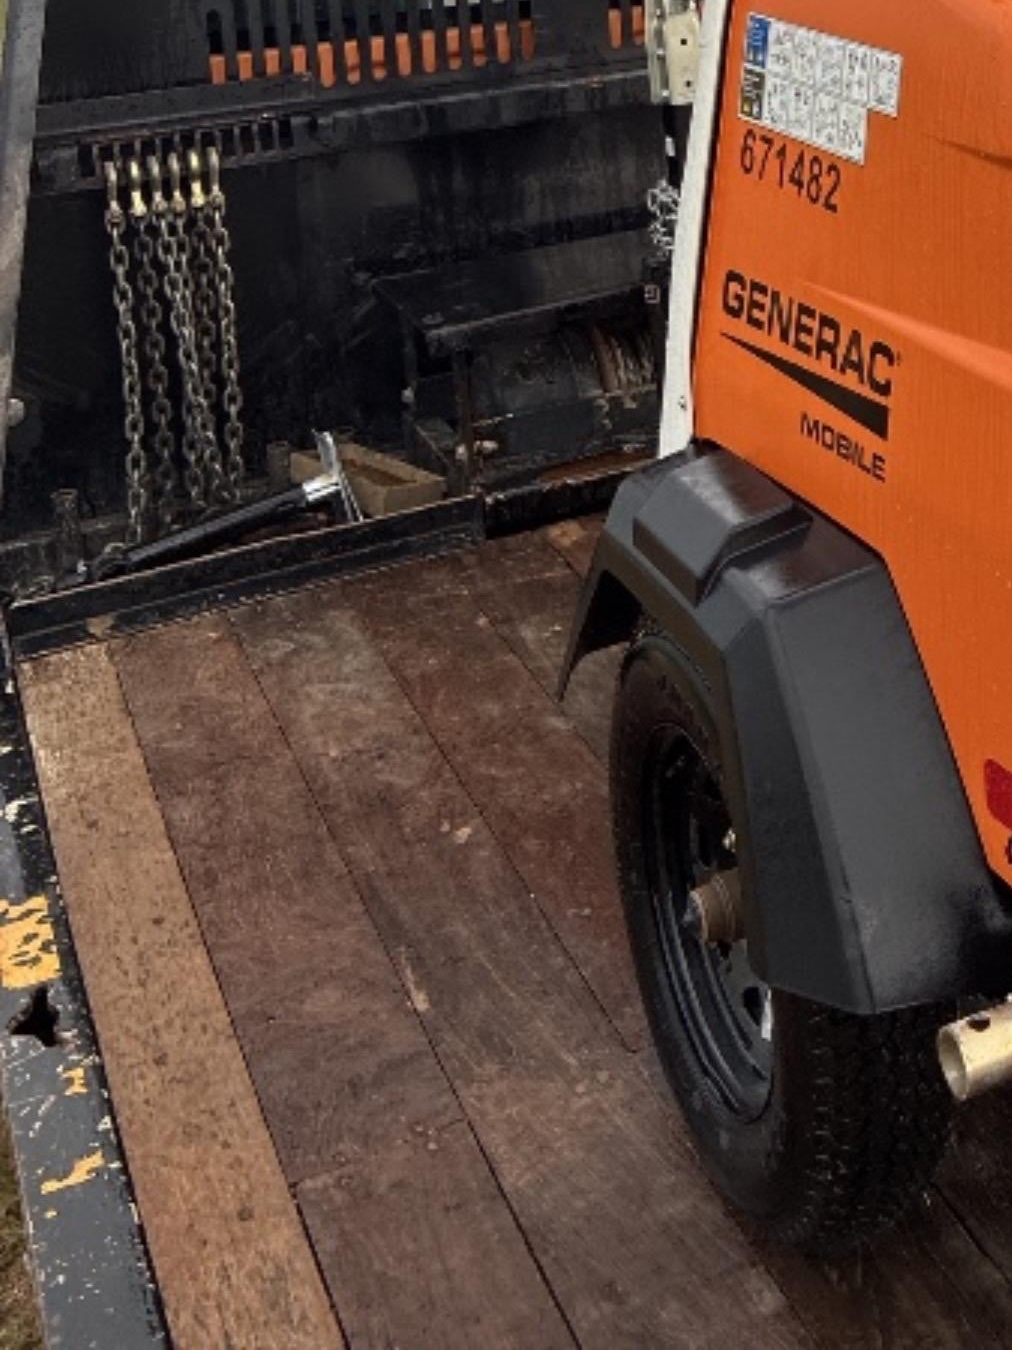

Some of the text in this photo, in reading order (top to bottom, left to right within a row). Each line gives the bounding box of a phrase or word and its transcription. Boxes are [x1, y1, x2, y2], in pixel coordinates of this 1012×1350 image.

[740, 129, 842, 214] 671482
[722, 269, 895, 398] GENERAC
[800, 412, 887, 484] MOBILE
